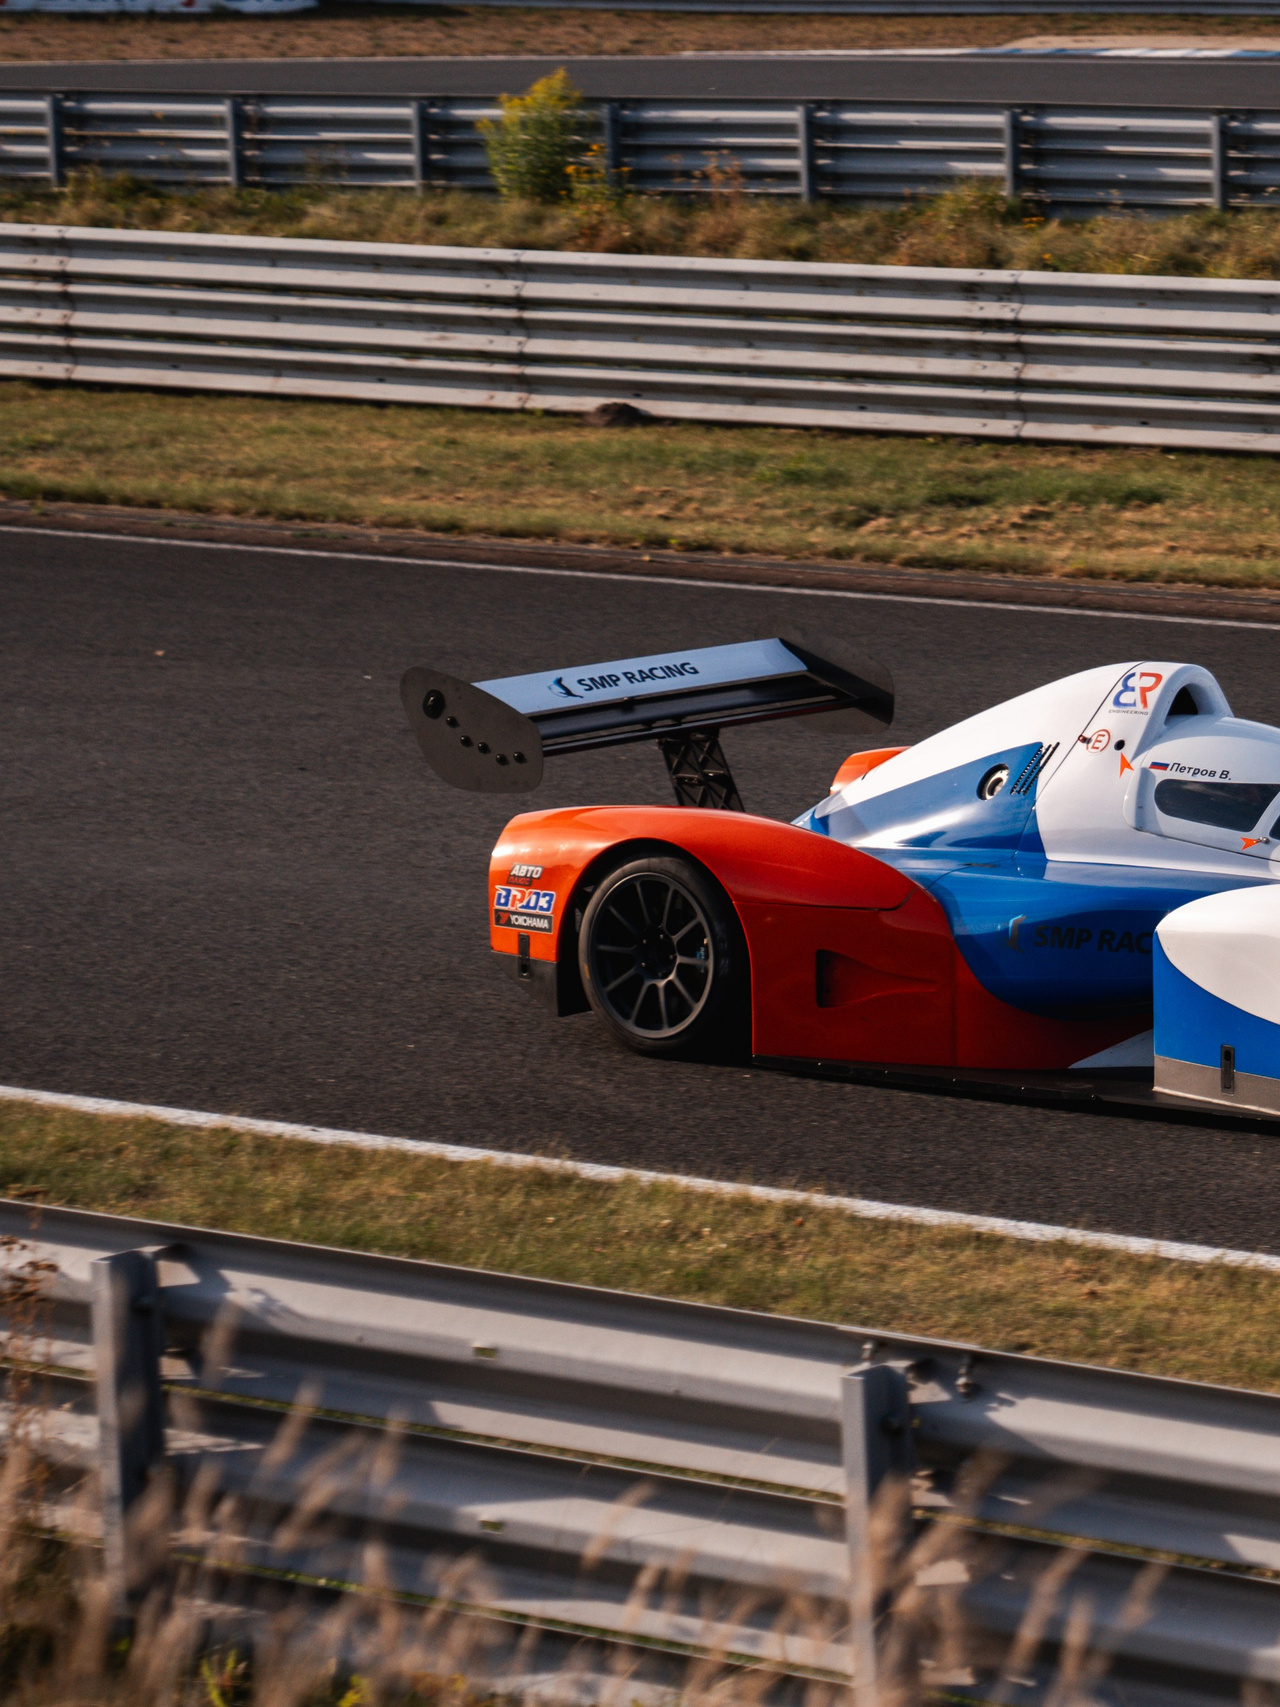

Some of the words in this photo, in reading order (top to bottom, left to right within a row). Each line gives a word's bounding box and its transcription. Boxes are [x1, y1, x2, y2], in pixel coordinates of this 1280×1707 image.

[577, 673, 620, 692] SMP
[622, 662, 699, 684] RACING
[1169, 762, 1217, 778] Петров
[1219, 769, 1232, 780] В.
[510, 864, 543, 879] АВТО
[510, 914, 549, 929] YOKOHAMA
[1033, 926, 1093, 950] SMP
